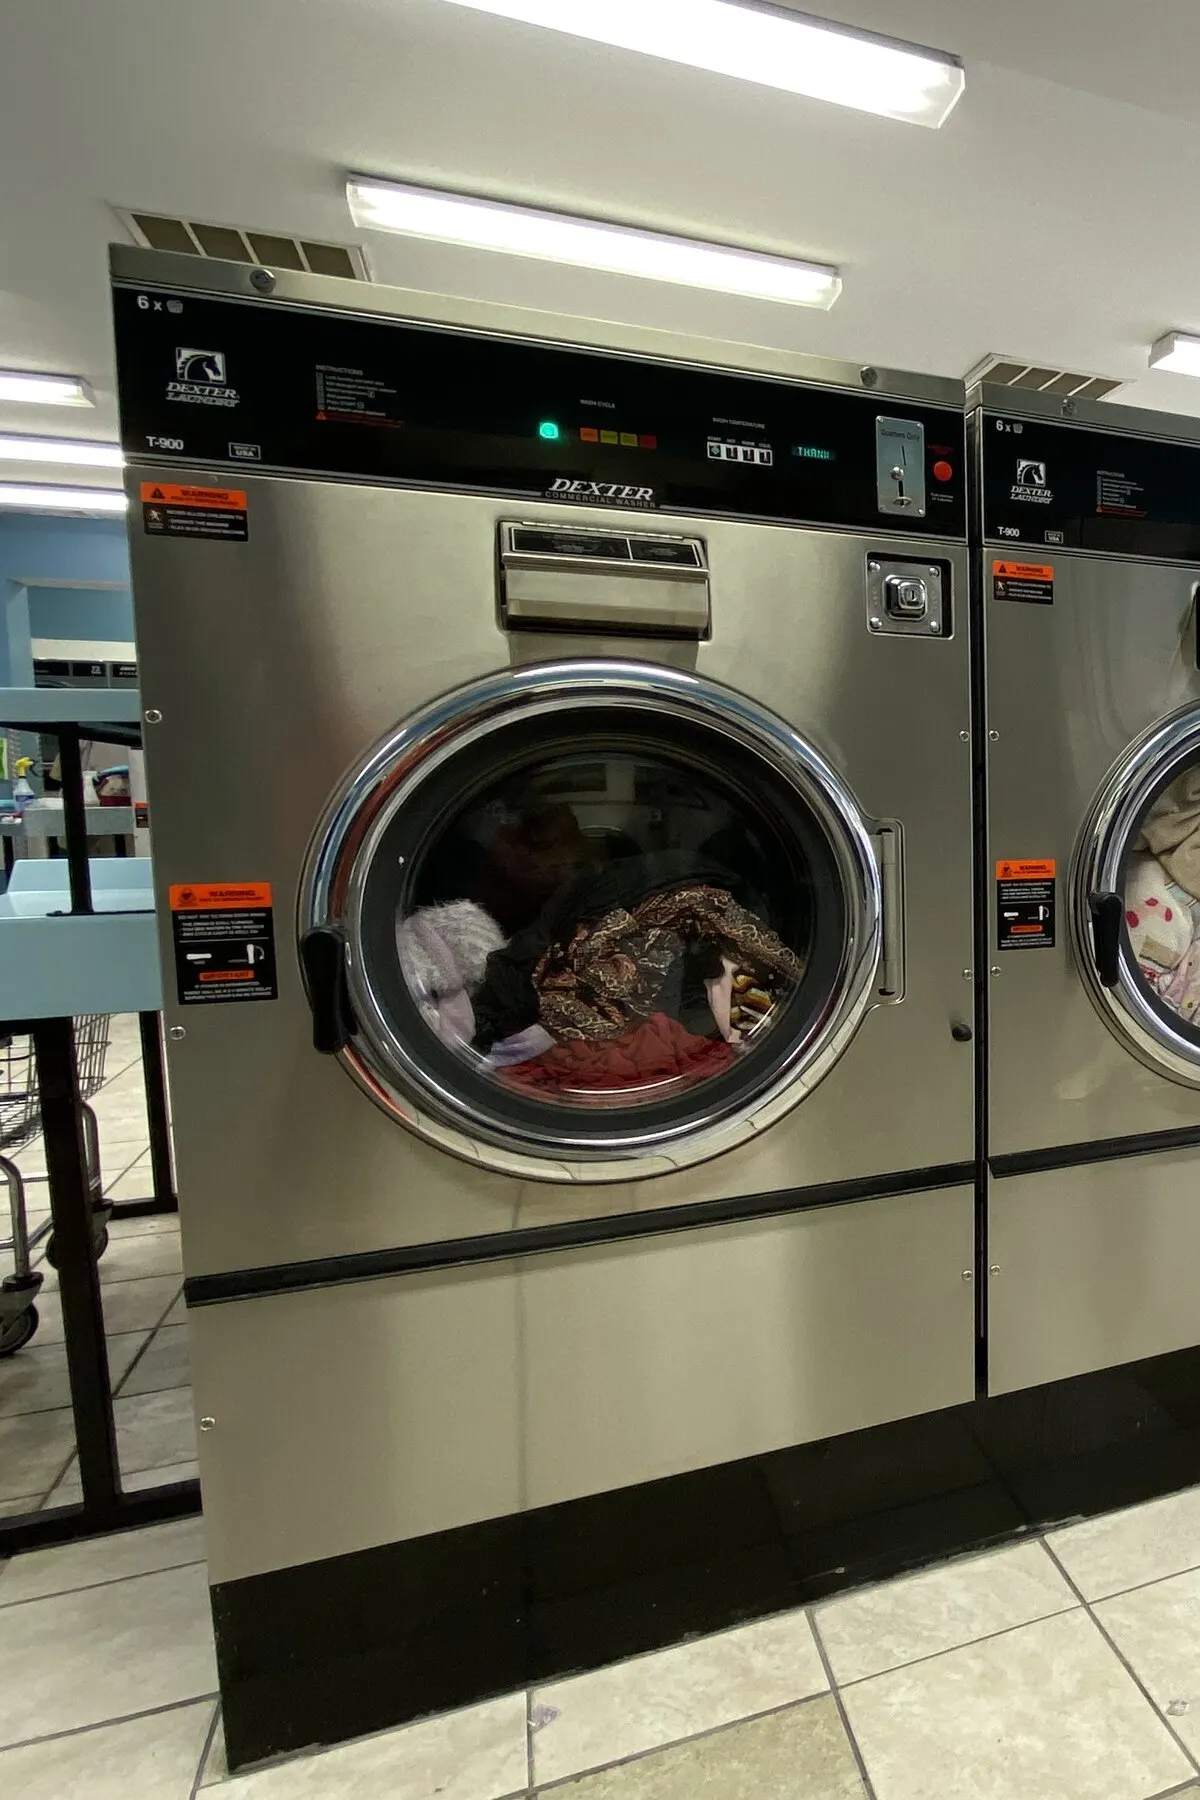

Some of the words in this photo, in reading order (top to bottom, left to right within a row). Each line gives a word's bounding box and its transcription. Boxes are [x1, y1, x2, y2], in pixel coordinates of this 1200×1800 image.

[137, 295, 150, 310] 6
[166, 381, 239, 399] DEXTER
[166, 392, 240, 407] LAUNDRY
[995, 420, 1004, 432] 6
[145, 435, 184, 451] T-900
[548, 478, 654, 501] DEXTER
[1010, 485, 1053, 498] DEXTER
[544, 491, 612, 505] COMMERCIAL
[615, 497, 656, 509] WASHER
[997, 526, 1020, 538] T-900
